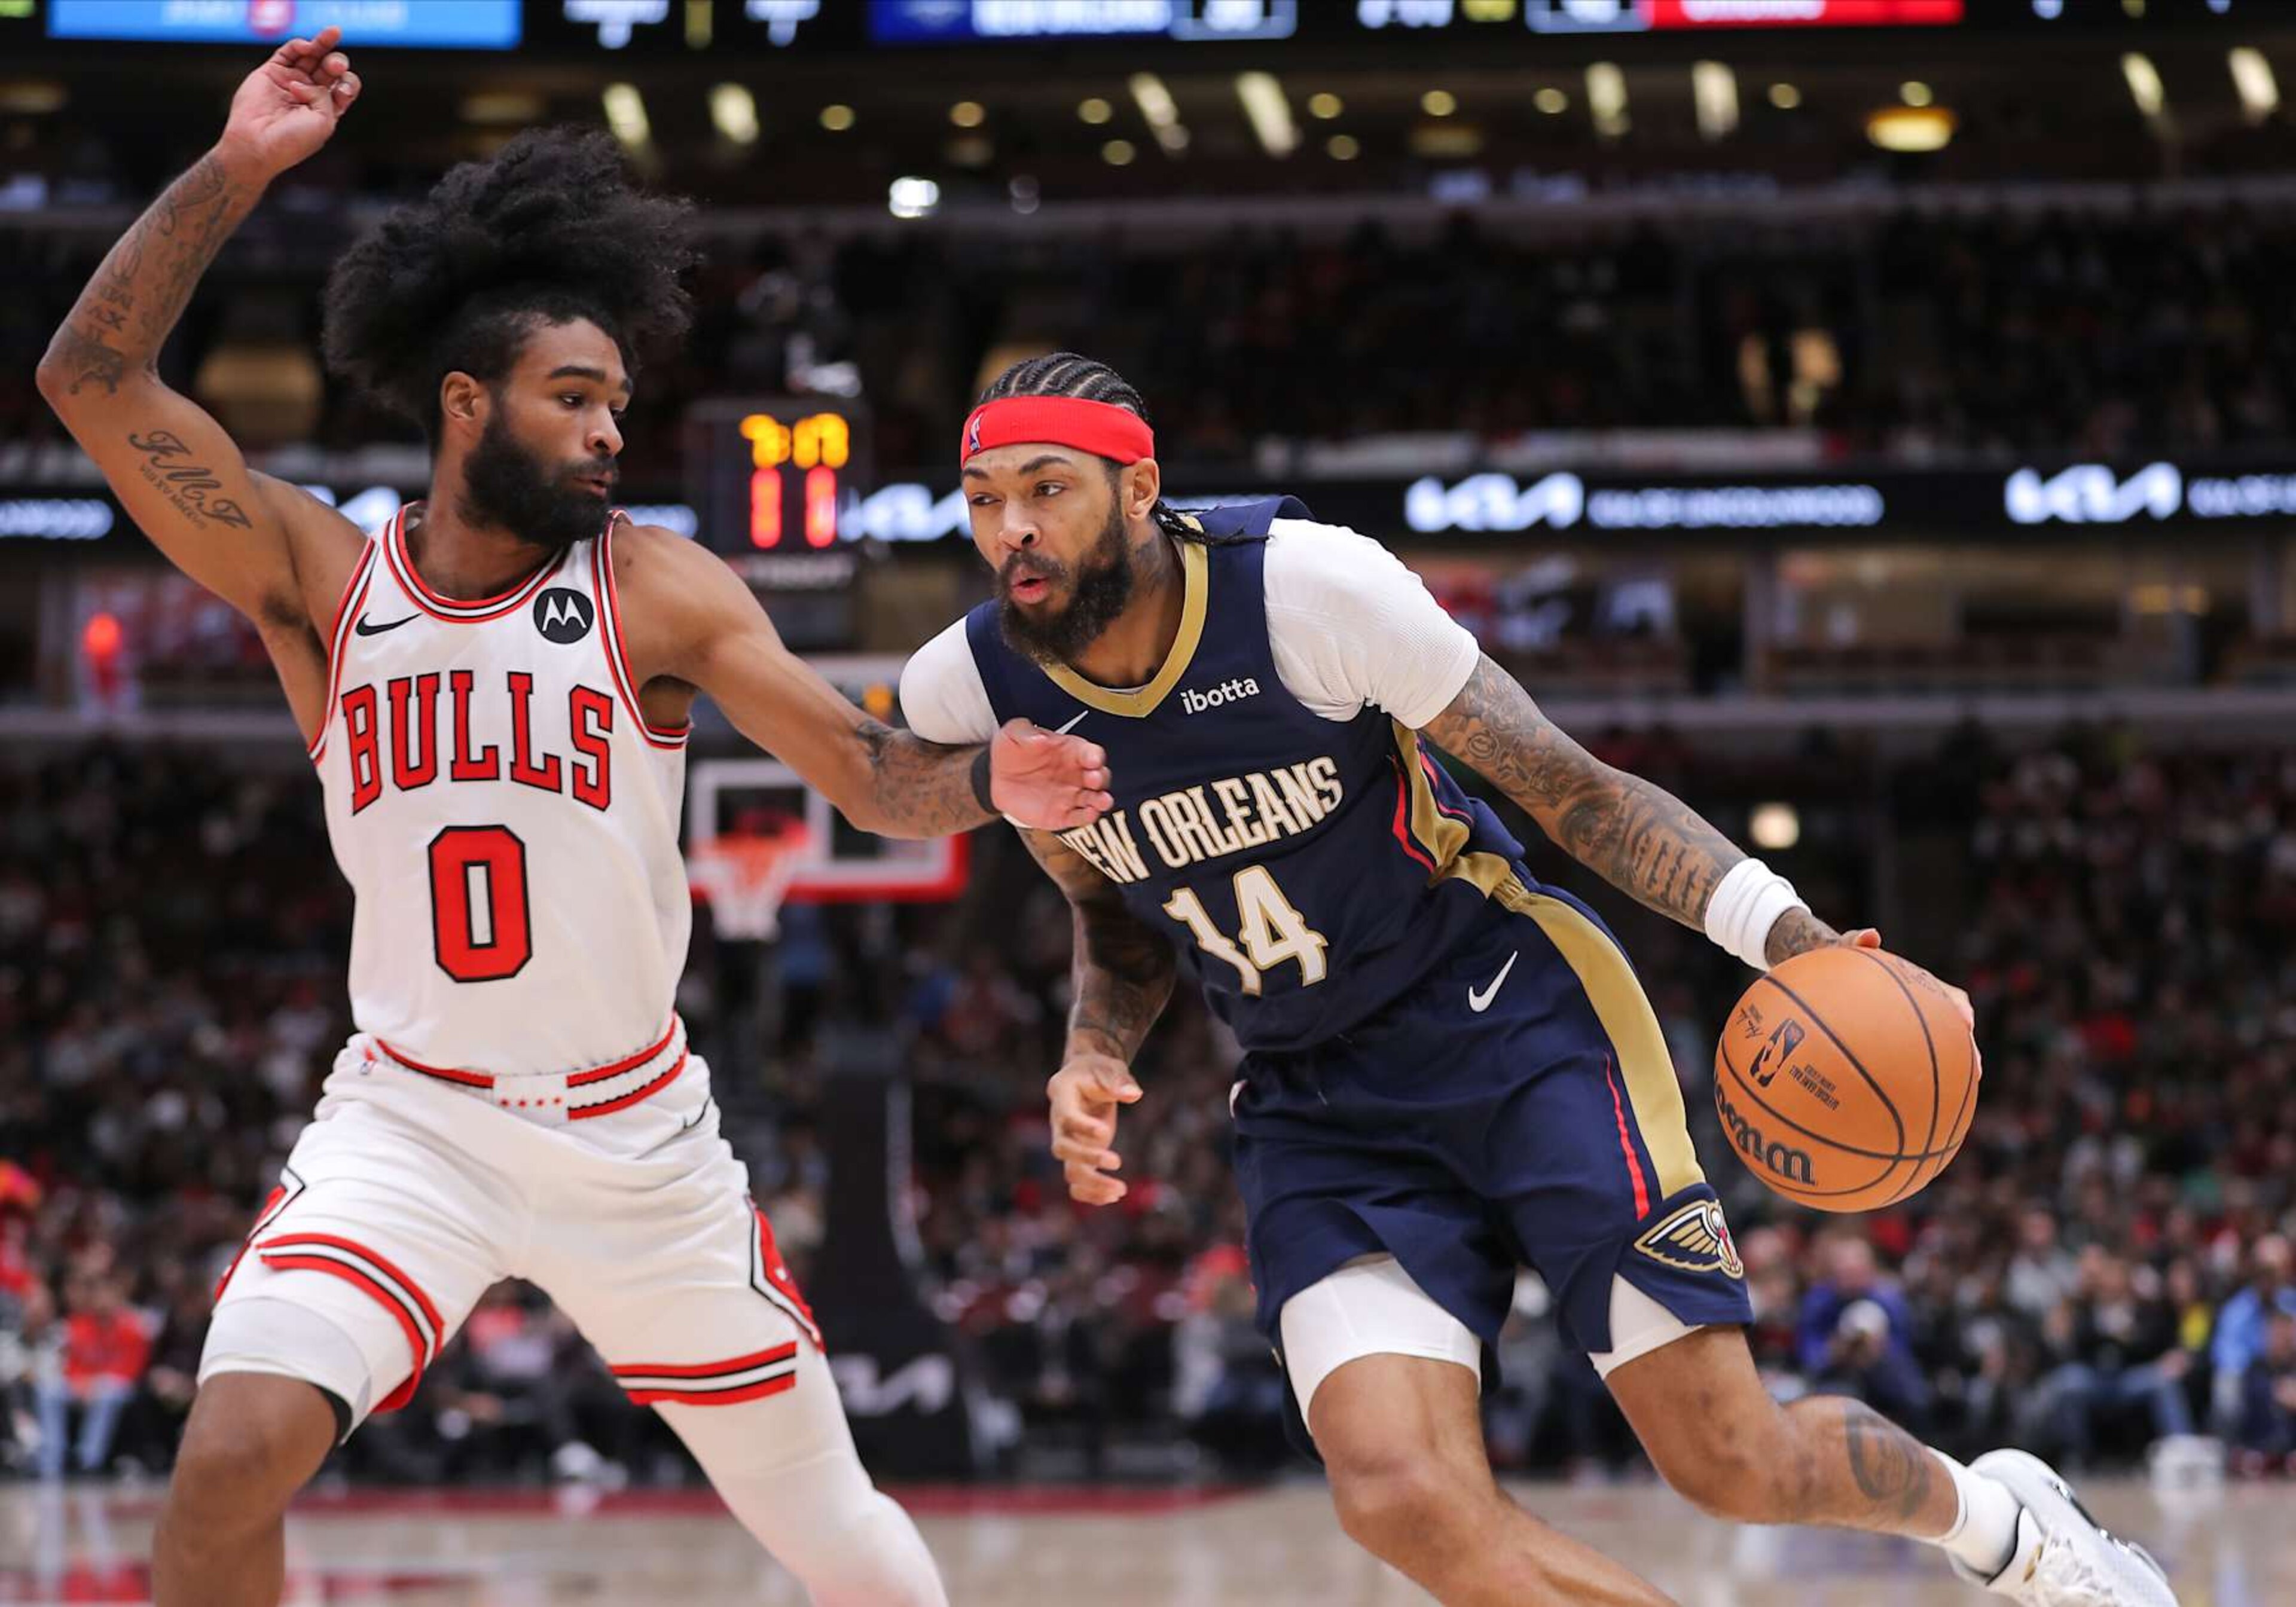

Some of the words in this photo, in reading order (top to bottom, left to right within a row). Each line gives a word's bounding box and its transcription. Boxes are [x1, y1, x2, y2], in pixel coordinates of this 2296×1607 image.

[341, 670, 613, 816] BULLS
[1180, 678, 1260, 715] ibotta
[1138, 755, 1344, 869] ORLEANS
[428, 824, 533, 983] 0
[1162, 864, 1329, 997] 14
